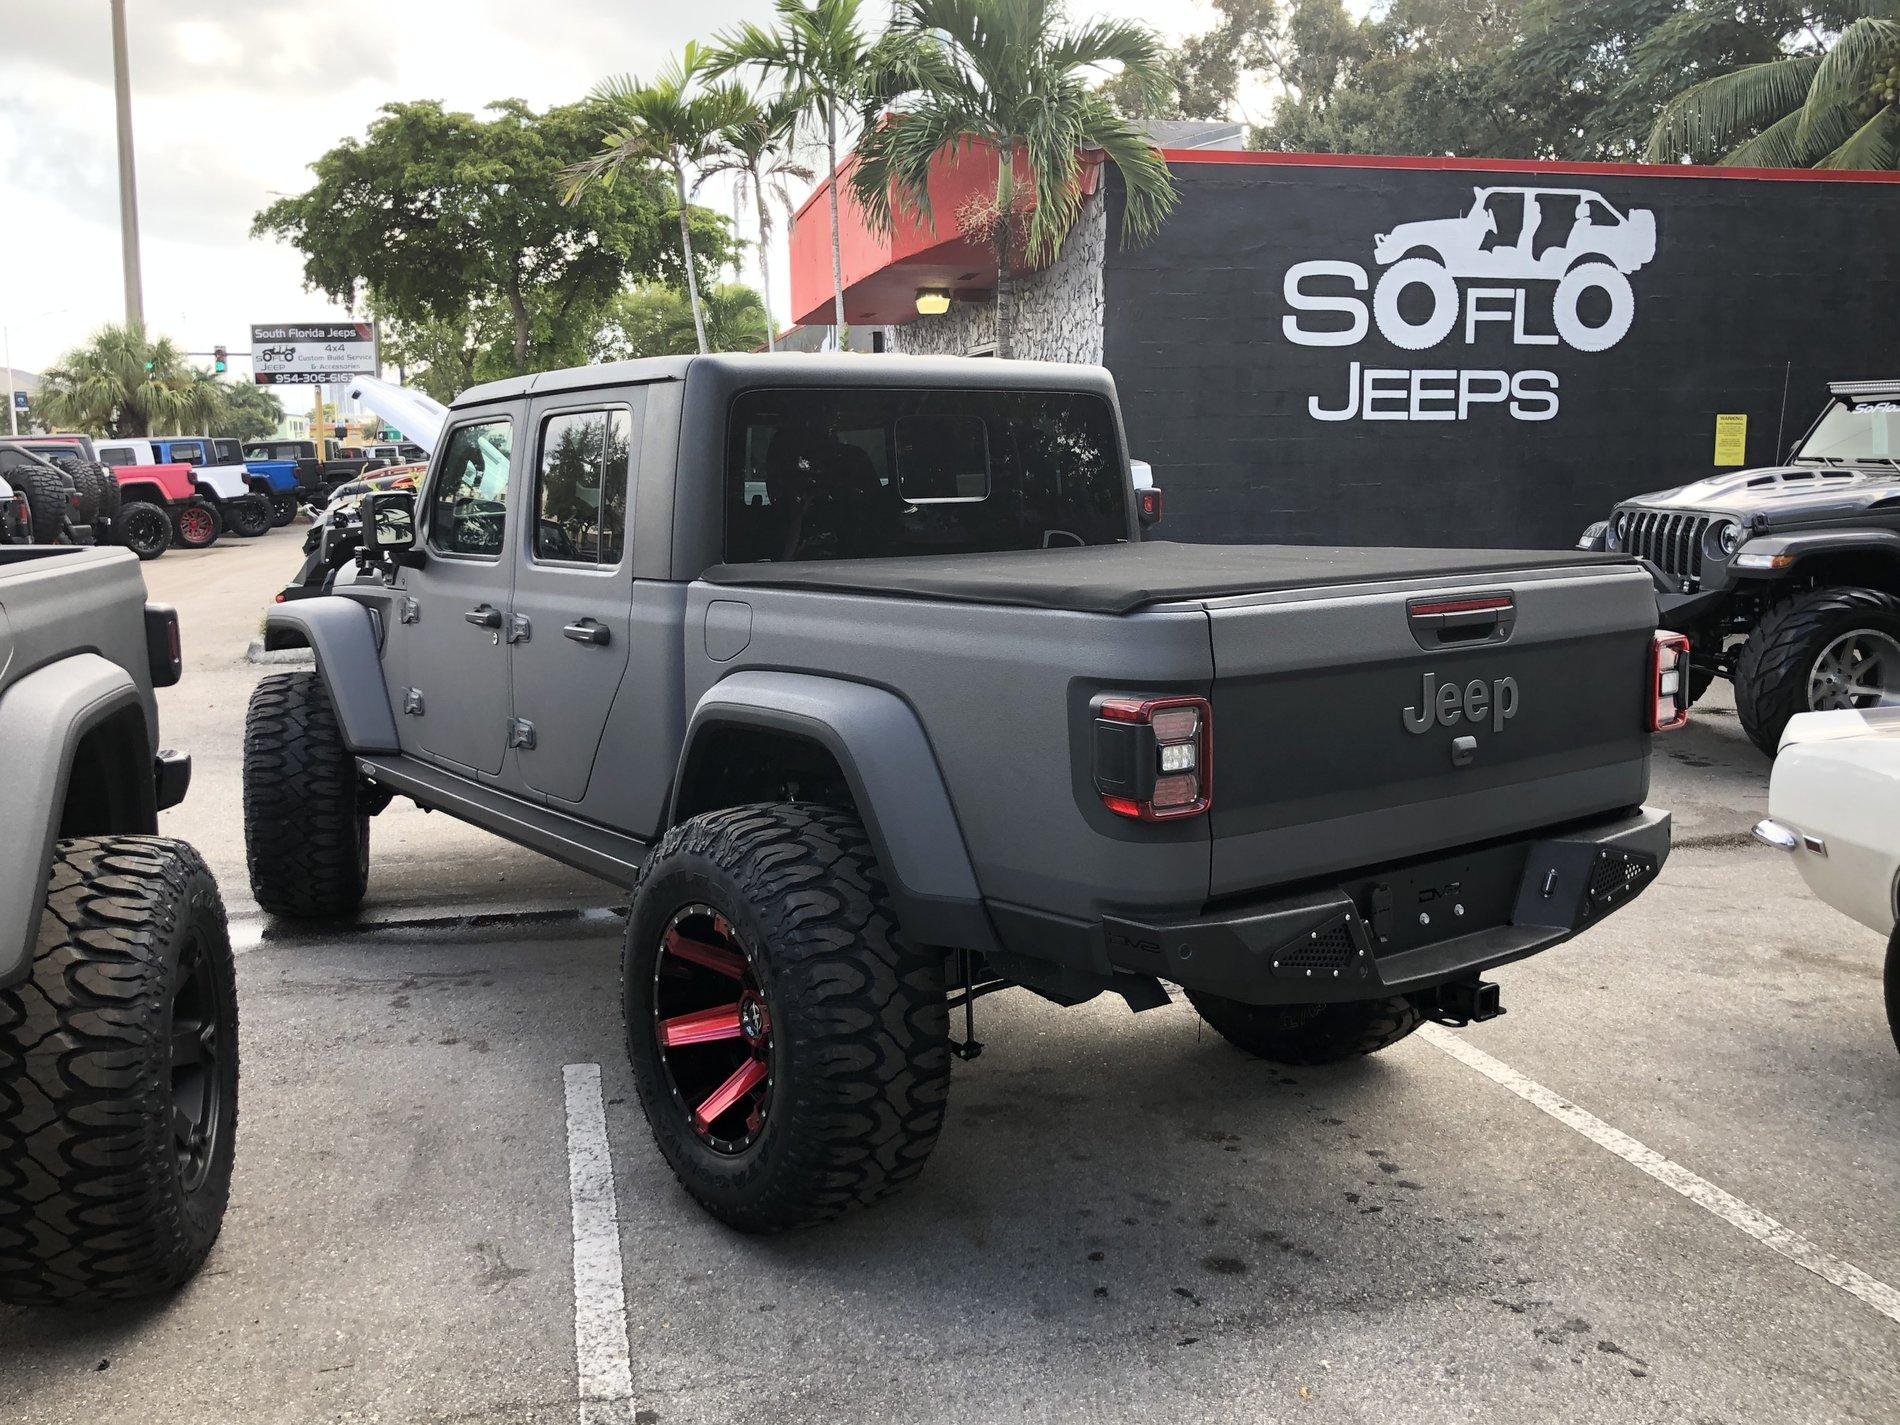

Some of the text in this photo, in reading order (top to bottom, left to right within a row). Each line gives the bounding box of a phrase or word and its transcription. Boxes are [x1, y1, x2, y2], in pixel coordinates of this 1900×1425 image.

[255, 328, 356, 339] South Florida Jeeps
[325, 344, 345, 352] 4x4
[1308, 361, 1559, 422] JEEPS
[1403, 672, 1519, 734] Jeep
